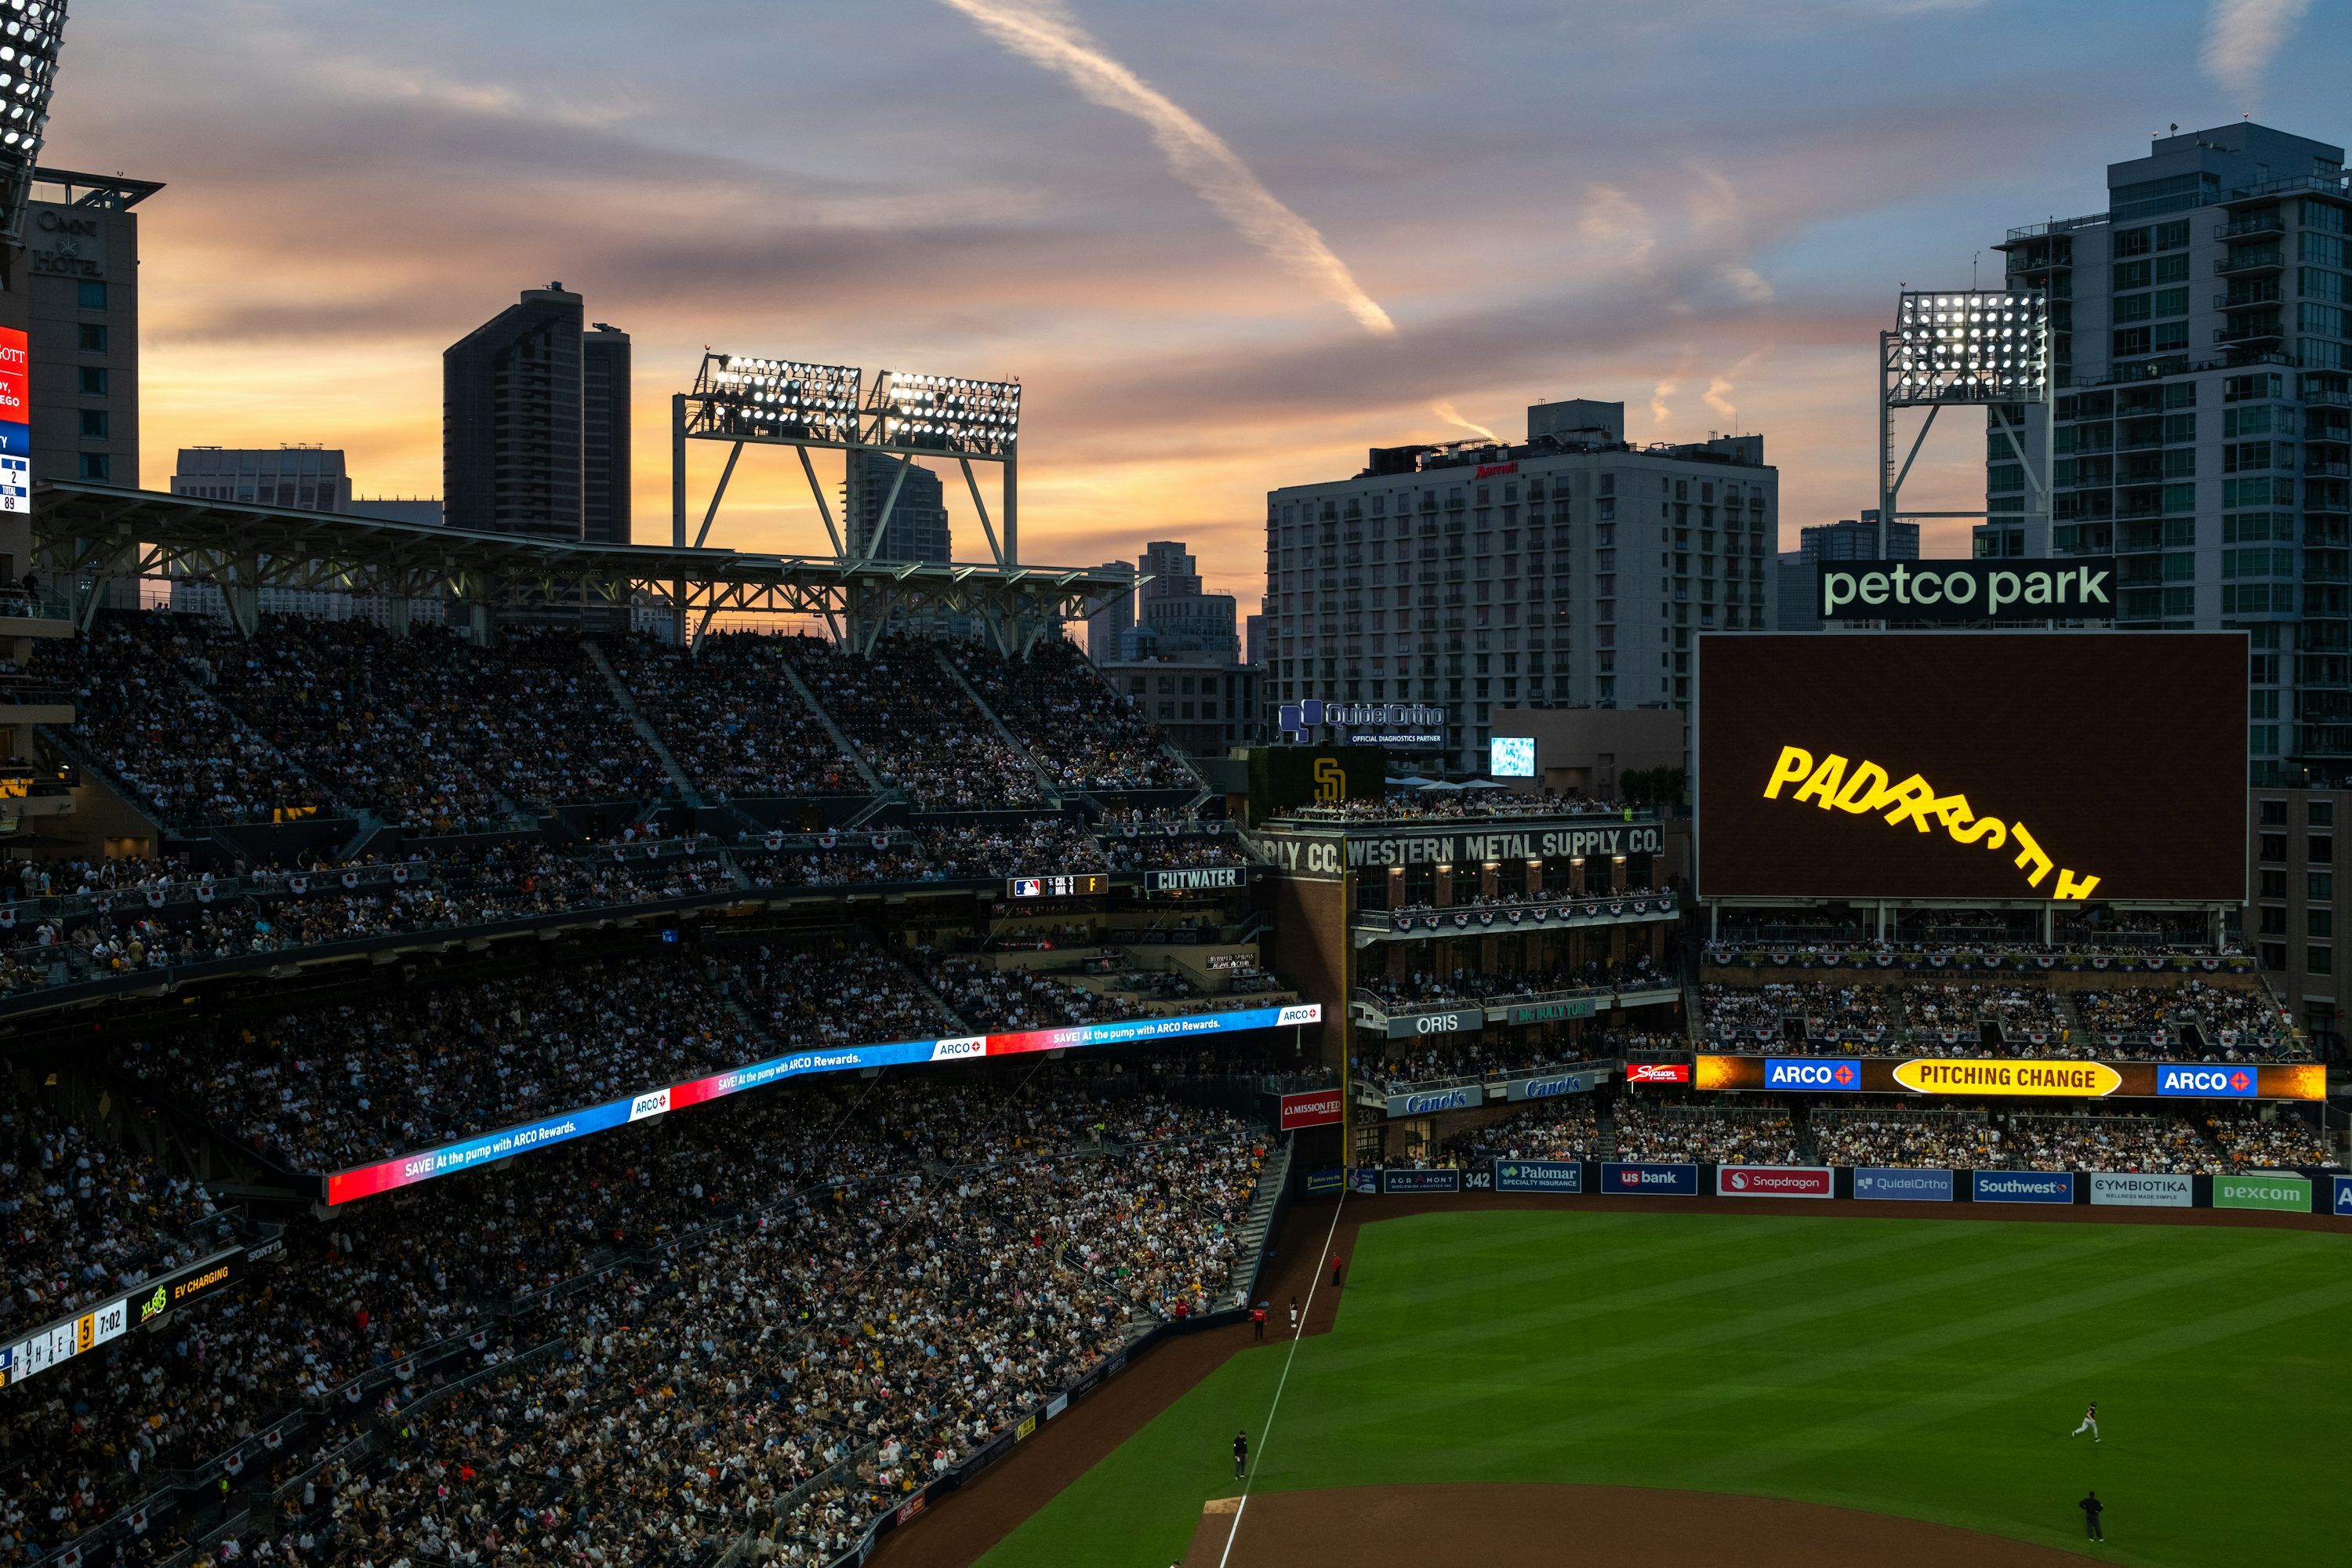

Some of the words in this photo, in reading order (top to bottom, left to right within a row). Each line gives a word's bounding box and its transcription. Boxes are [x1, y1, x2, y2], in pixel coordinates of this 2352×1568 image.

[38, 211, 97, 238] OMNI
[33, 249, 103, 276] HOTEL
[12, 461, 16, 470] K
[1475, 461, 1518, 479] Marriott
[12, 471, 16, 484] 2
[2, 486, 16, 495] TOTAL
[5, 497, 14, 510] 89
[1825, 564, 1976, 615] petco
[1989, 566, 2110, 615] park
[1326, 703, 1445, 730] QuidelOrtho
[1763, 746, 2006, 849] PADRES
[1346, 837, 1454, 866] WESTERN
[1465, 833, 1537, 861] METAL
[1542, 830, 1621, 857] SUPPLY
[1629, 829, 1662, 853] CO.
[1308, 843, 1342, 874] CO.
[1055, 877, 1066, 886] COL
[1069, 877, 1074, 885] 3
[1090, 877, 1095, 891] F
[1158, 869, 1236, 890] CUTWATER
[1055, 886, 1066, 895] MIA
[1069, 886, 1073, 895] 4
[2002, 971, 2048, 980] LANDING
[1284, 1010, 1308, 1021] ARCO
[1519, 1008, 1534, 1022] BIG
[1537, 1005, 1564, 1019] BULLY
[1566, 1003, 1589, 1017] TURF
[1054, 1032, 1080, 1044] SAVE!
[1082, 1031, 1092, 1040] At
[1094, 1029, 1109, 1040] the
[1110, 1027, 1134, 1040] pump
[1137, 1022, 1155, 1036] with
[1157, 1022, 1181, 1033] ARCO
[1182, 1018, 1221, 1031] Rewards.
[1416, 1014, 1458, 1034] ORIS
[940, 1043, 970, 1055] ARCO
[718, 1077, 737, 1091] SAVE!
[739, 1075, 746, 1085] At
[746, 1073, 757, 1083] the
[757, 1069, 775, 1082] pump
[775, 1063, 788, 1075] with
[789, 1057, 811, 1070] ARCO
[814, 1054, 862, 1067] Rewards.
[1637, 1065, 1676, 1080] Sycuan
[1772, 1066, 1832, 1084] ARCO
[1921, 1065, 2011, 1086] PITCHING
[2017, 1068, 2096, 1088] CHANGE
[1525, 1076, 1581, 1098] Canel's
[2164, 1072, 2227, 1091] ARCO
[636, 1098, 658, 1113] ARCO
[1294, 1102, 1326, 1113] MISSION
[1327, 1101, 1341, 1110] FED
[1406, 1090, 1466, 1113] Canel's
[1357, 1109, 1378, 1125] 336
[405, 1157, 434, 1177] SAVE!
[436, 1155, 447, 1168] At
[448, 1152, 463, 1165] the
[466, 1145, 491, 1163] pump
[493, 1138, 511, 1152] with
[514, 1130, 537, 1148] ARCO
[539, 1121, 576, 1140] Rewards.
[1465, 1172, 1490, 1188] 342
[1520, 1166, 1577, 1179] Palomar
[1622, 1172, 1639, 1183] us
[1641, 1171, 1676, 1184] bank
[1753, 1176, 1820, 1189] Snapdragon
[1878, 1178, 1948, 1189] QuidelOrtho
[1980, 1180, 2056, 1194] Southwest
[2095, 1180, 2187, 1192] CYMBIOTIKA
[247, 1243, 274, 1262] SONY
[175, 1283, 187, 1299] EV
[187, 1266, 228, 1293] CHARGING
[71, 1321, 74, 1338] 1
[83, 1319, 89, 1341] 5
[100, 1311, 121, 1334] 7:02
[49, 1330, 53, 1346] 1
[58, 1337, 62, 1352] E
[27, 1340, 32, 1356] 0
[36, 1345, 41, 1363] H
[70, 1340, 74, 1356] 0
[13, 1356, 19, 1372] R
[49, 1349, 53, 1364] 4
[26, 1359, 31, 1375] 2
